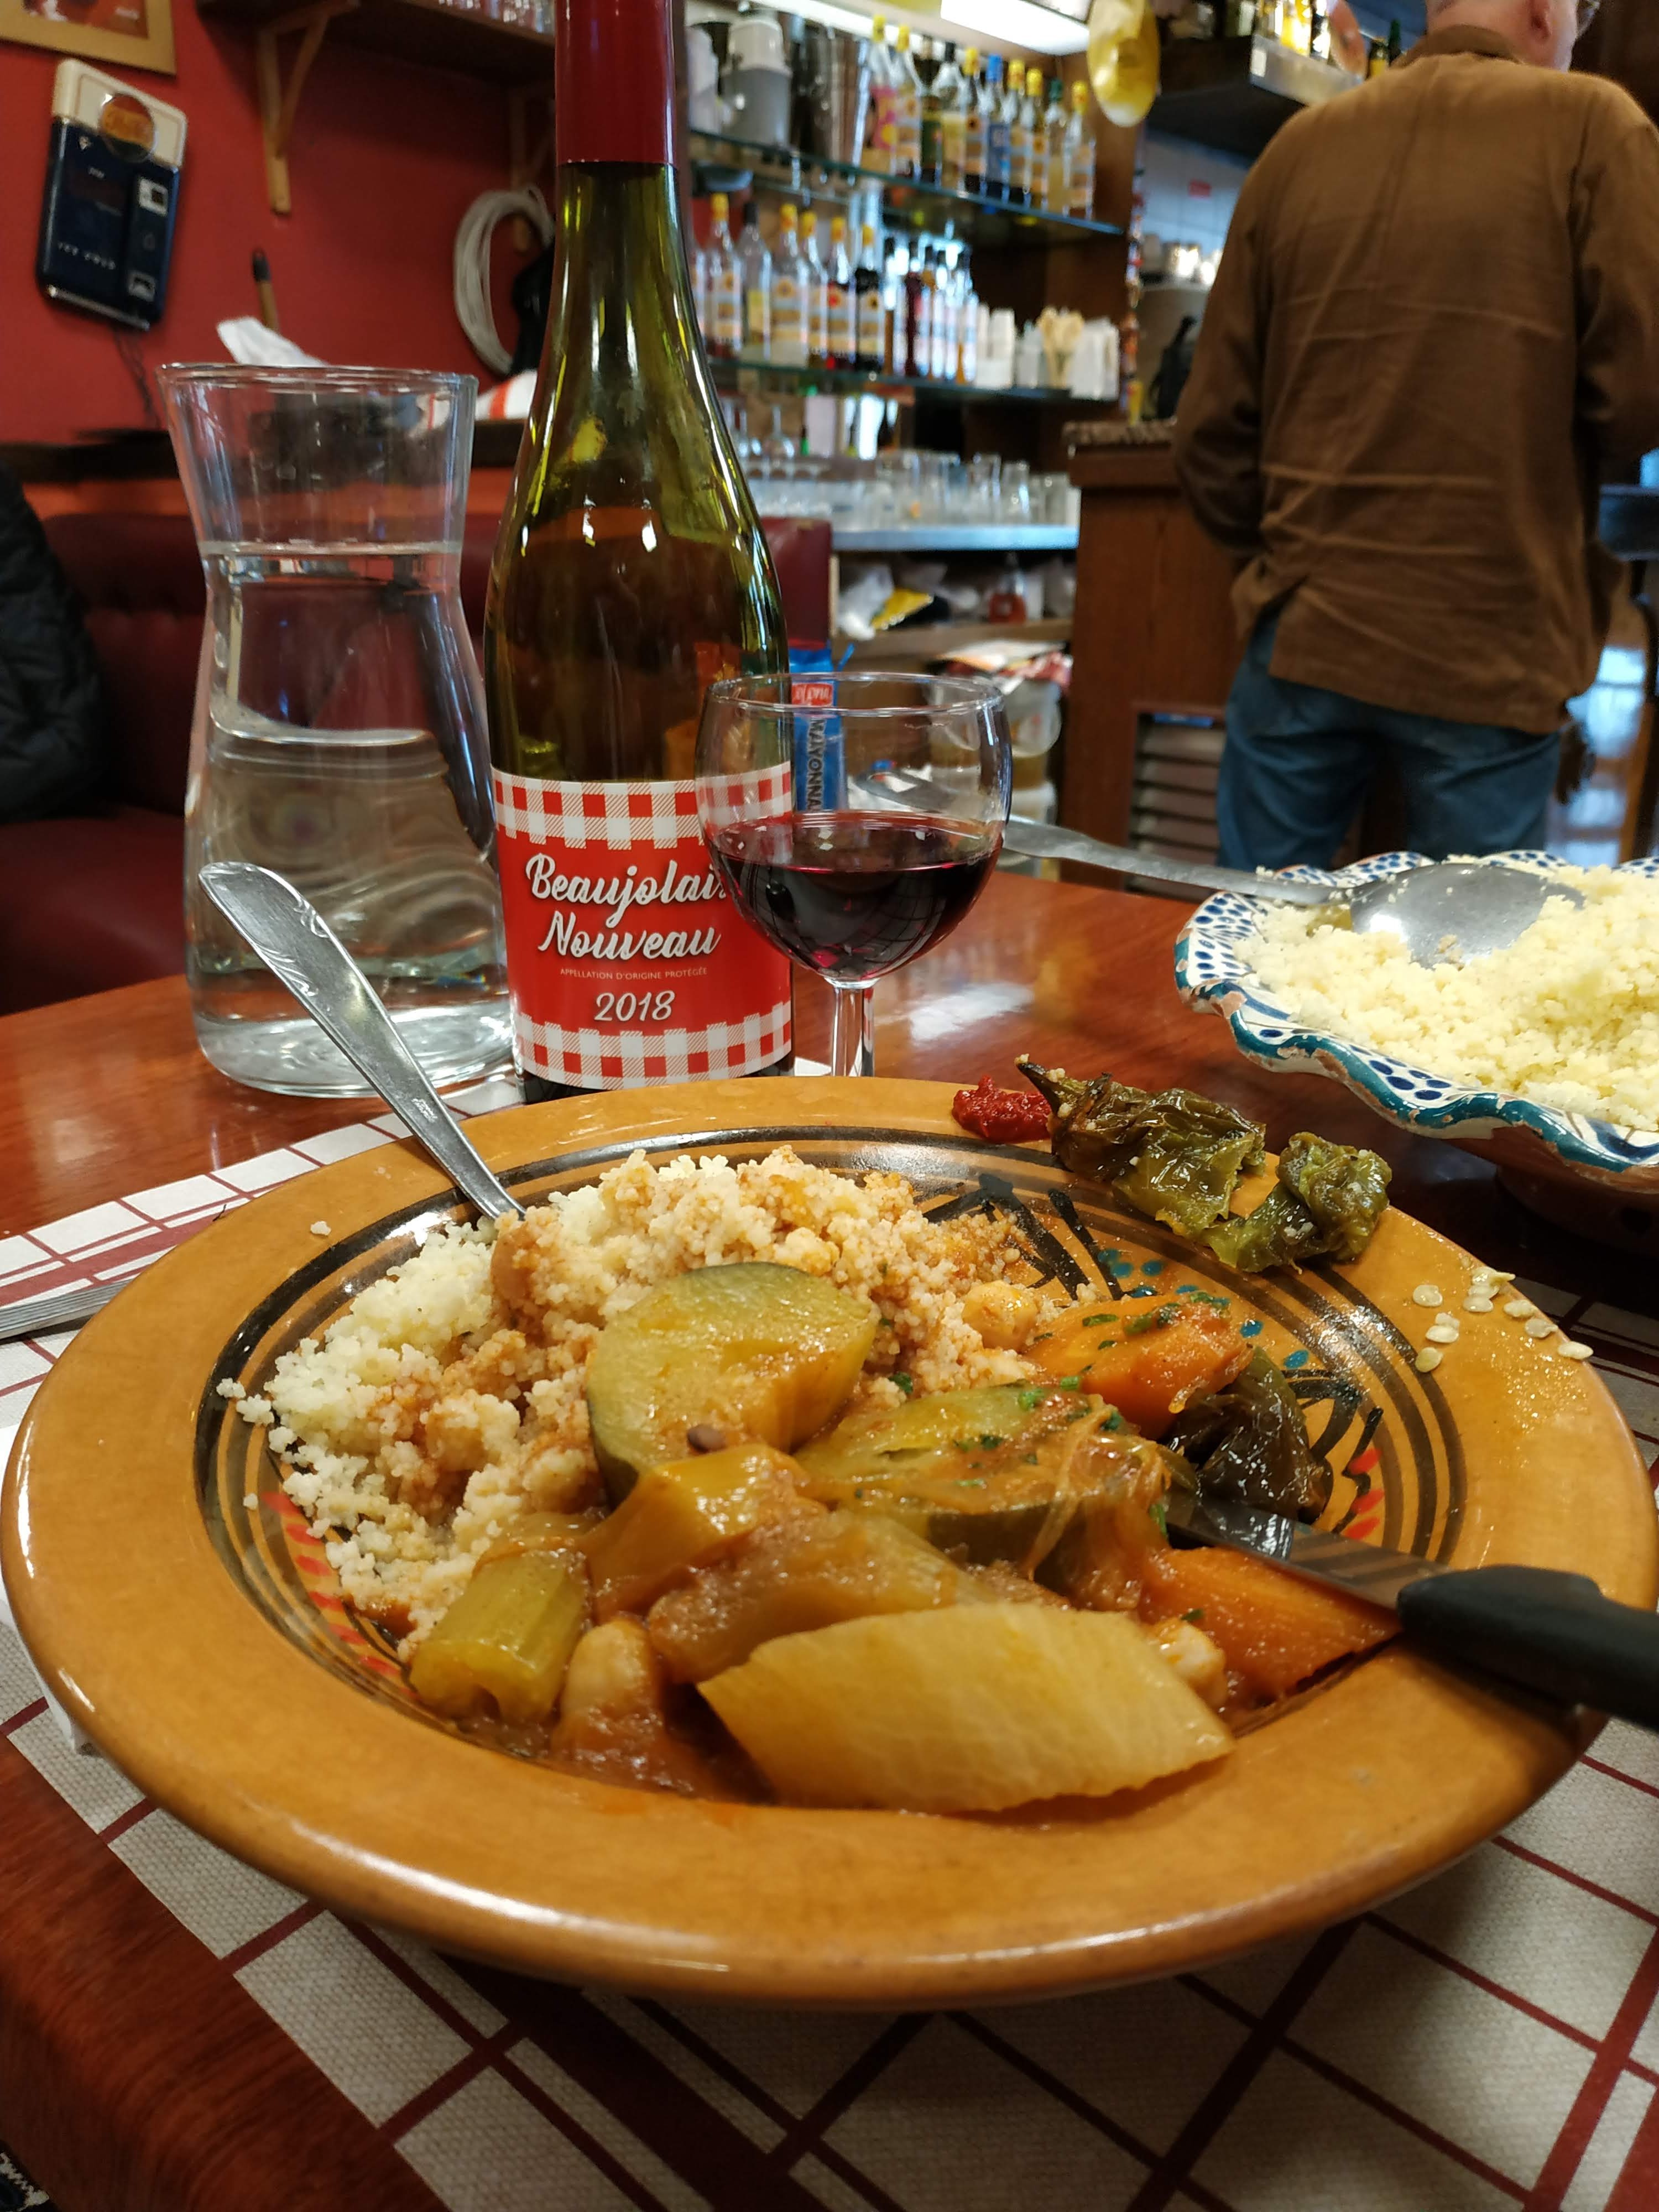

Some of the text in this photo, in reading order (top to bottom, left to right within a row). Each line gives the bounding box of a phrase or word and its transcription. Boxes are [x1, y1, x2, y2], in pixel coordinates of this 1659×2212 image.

[538, 910, 721, 961] Nouveau
[560, 967, 708, 980] APPELLATION D'ORIGINE PROTÉGÉE
[594, 990, 676, 1022] 2018
